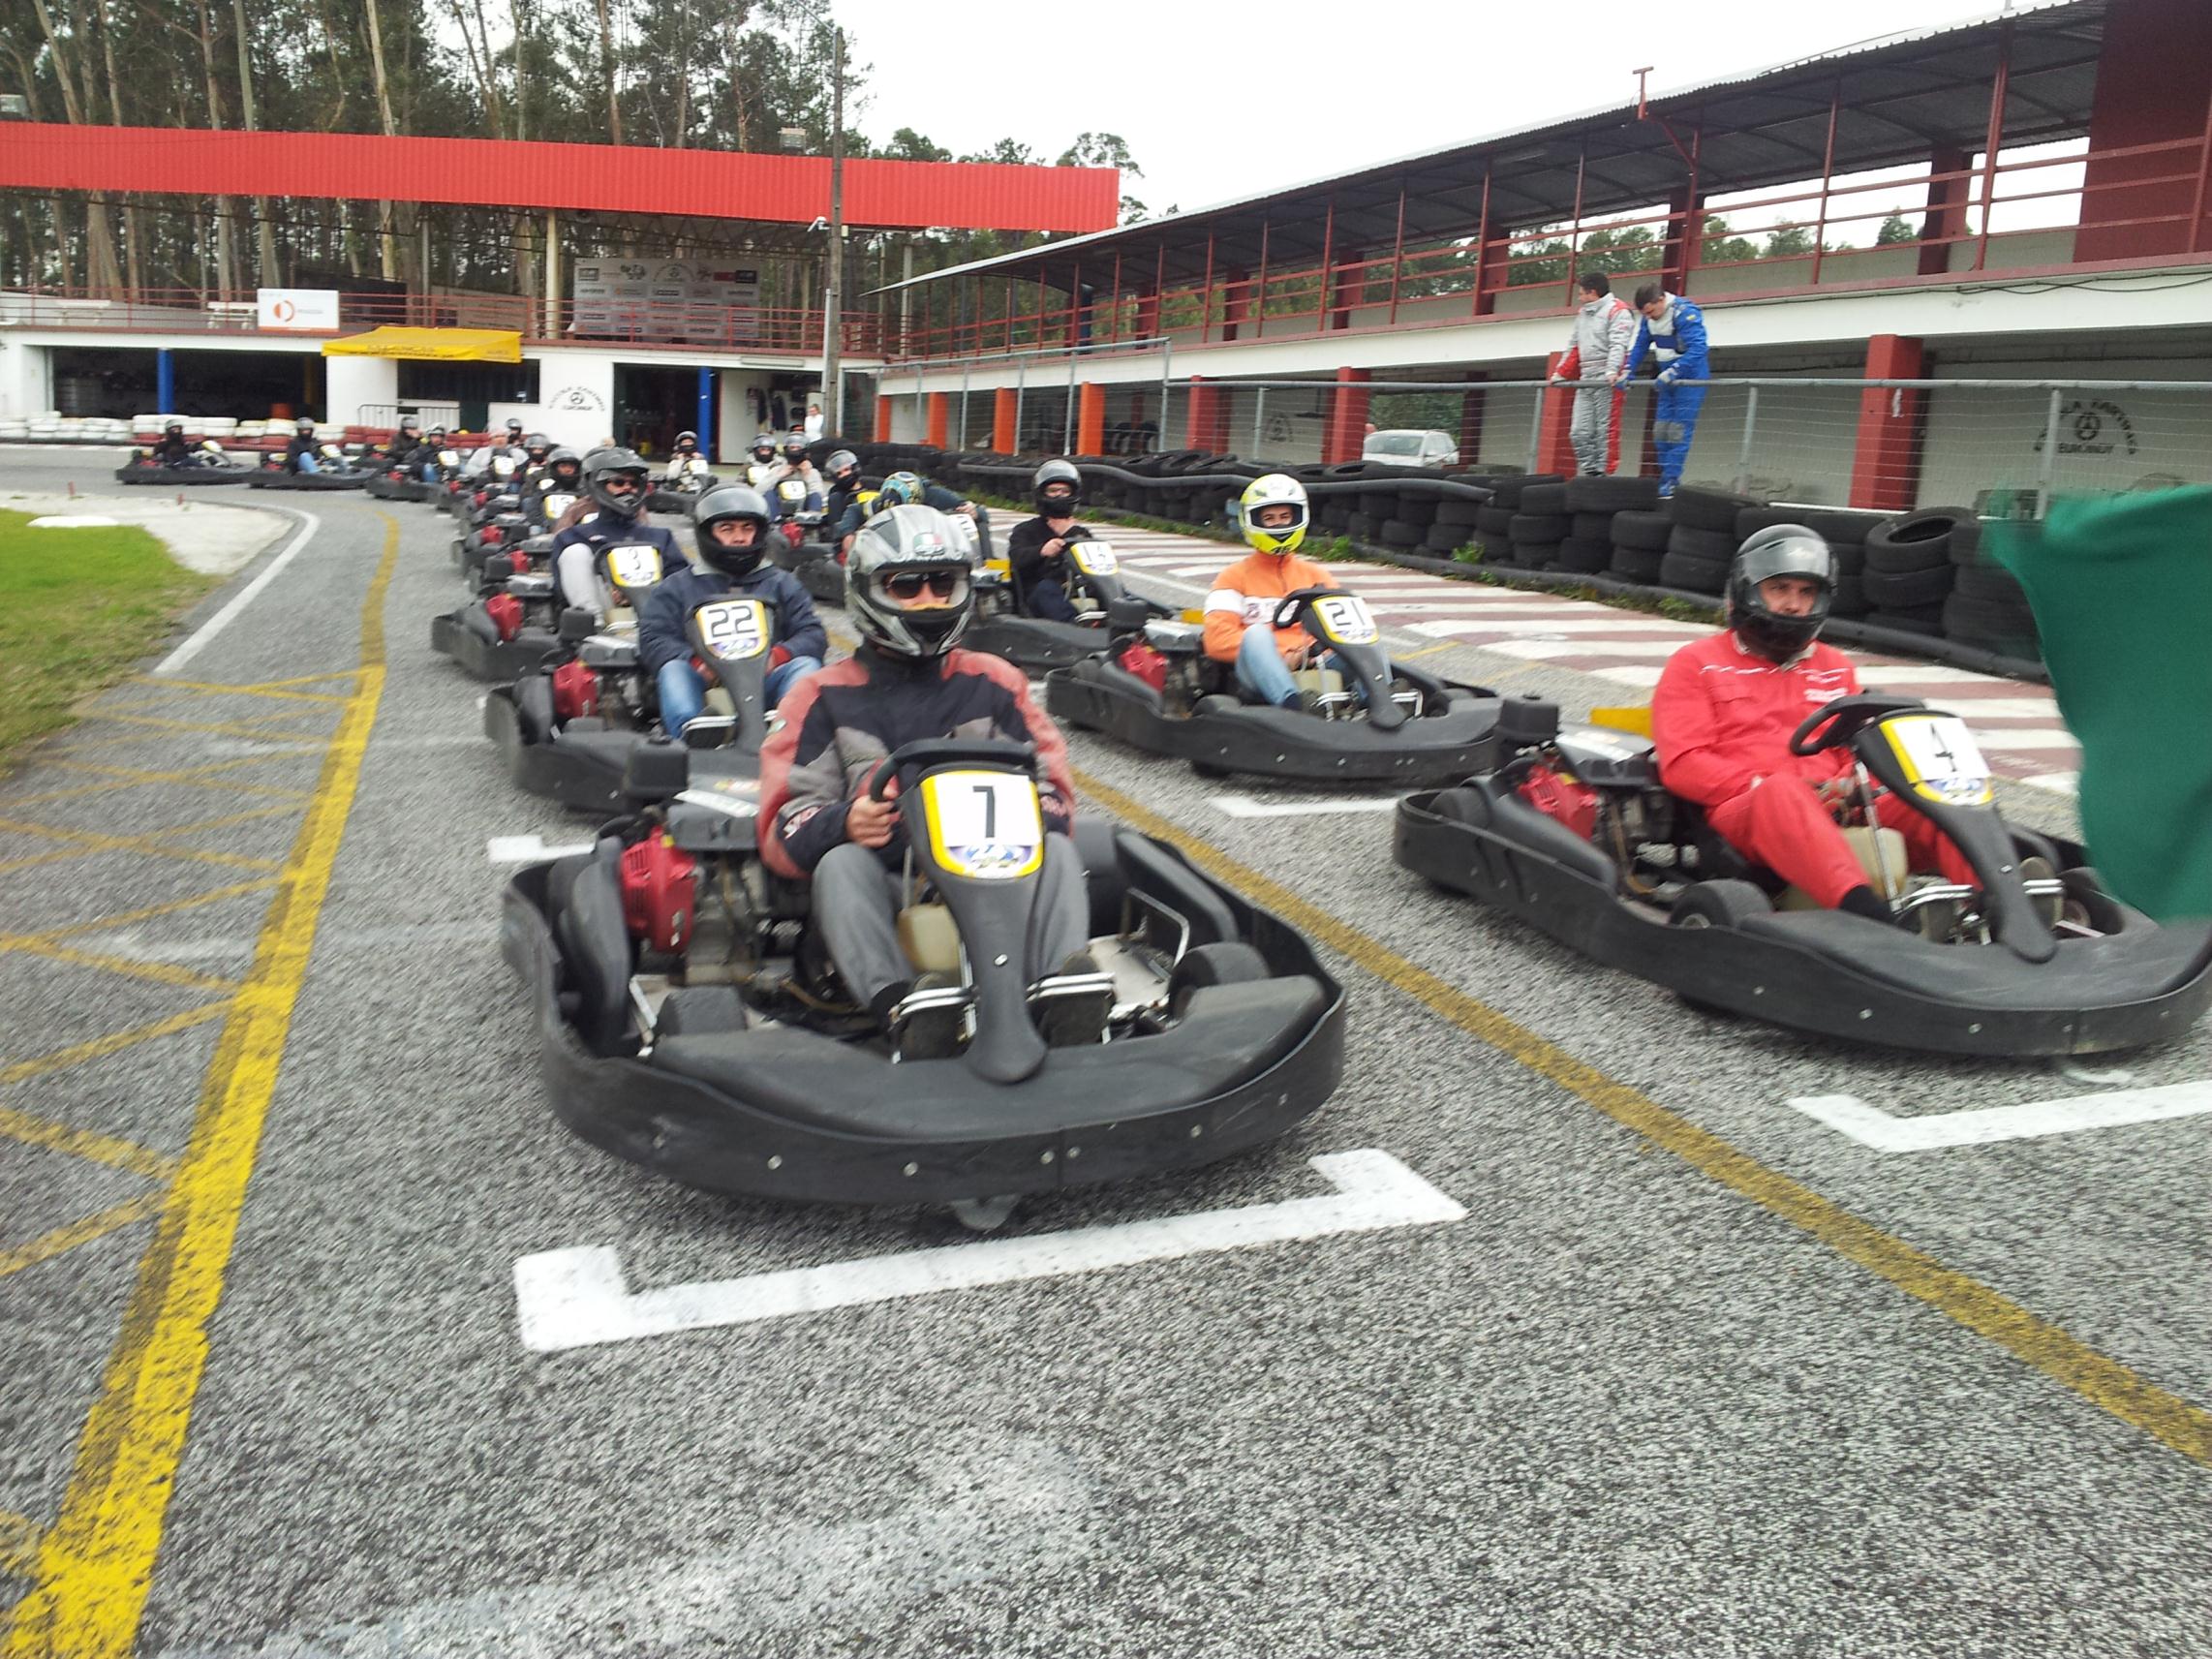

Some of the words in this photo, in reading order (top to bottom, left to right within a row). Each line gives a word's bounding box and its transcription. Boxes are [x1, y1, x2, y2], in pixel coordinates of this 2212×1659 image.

[628, 547, 641, 570] 3
[707, 604, 756, 638] 22
[1325, 599, 1367, 627] 21
[1929, 722, 1957, 773] 4
[972, 785, 997, 838] 7
